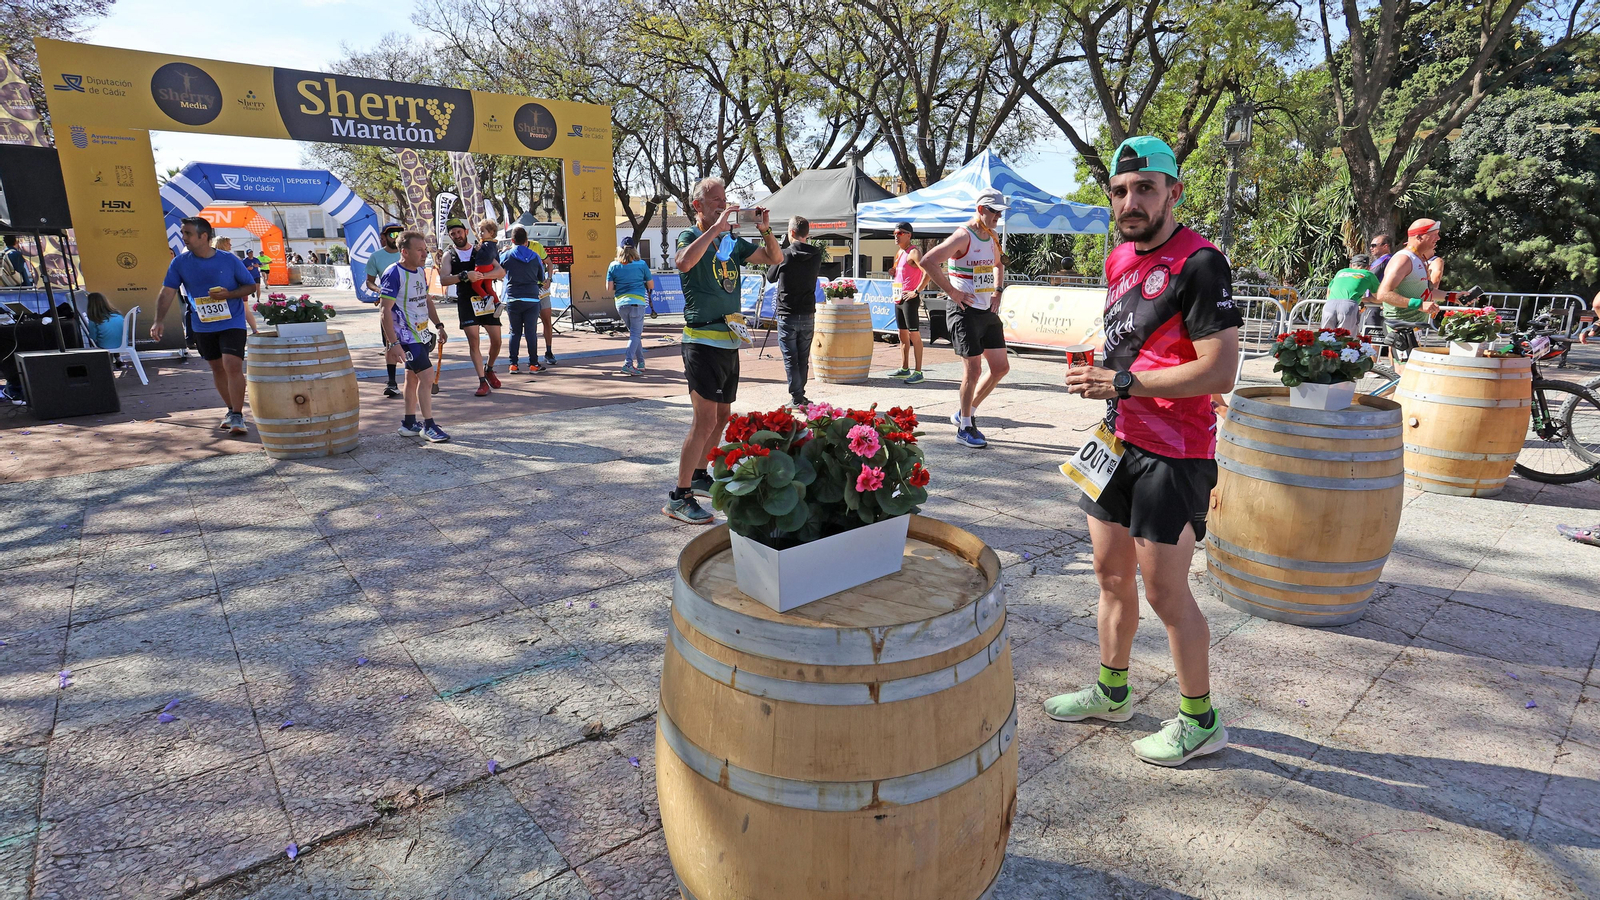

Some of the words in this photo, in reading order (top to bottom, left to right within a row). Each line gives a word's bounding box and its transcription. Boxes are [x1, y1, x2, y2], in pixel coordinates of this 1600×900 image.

[86, 75, 133, 88] Diputación
[102, 87, 126, 97] Cádiz
[158, 87, 215, 109] Sherry
[237, 98, 266, 108] Sherry
[180, 101, 208, 110] Media
[297, 78, 455, 140] Sherry
[330, 117, 436, 143] Maratón
[482, 121, 503, 130] Sherry
[517, 122, 553, 137] Sherry
[583, 125, 608, 133] Diputación
[91, 133, 136, 141] Ayuntamiento
[529, 131, 548, 139] Promo
[242, 174, 281, 184] Diputación
[286, 177, 321, 185] DEPORTES
[255, 184, 275, 192] Cádiz
[101, 200, 131, 209] HSN
[200, 210, 232, 224] SN
[966, 259, 994, 267] LIMERICK
[201, 303, 224, 315] 1330
[871, 304, 890, 316] Cádiz
[1030, 311, 1075, 328] Sherry
[1080, 440, 1110, 474] 007
